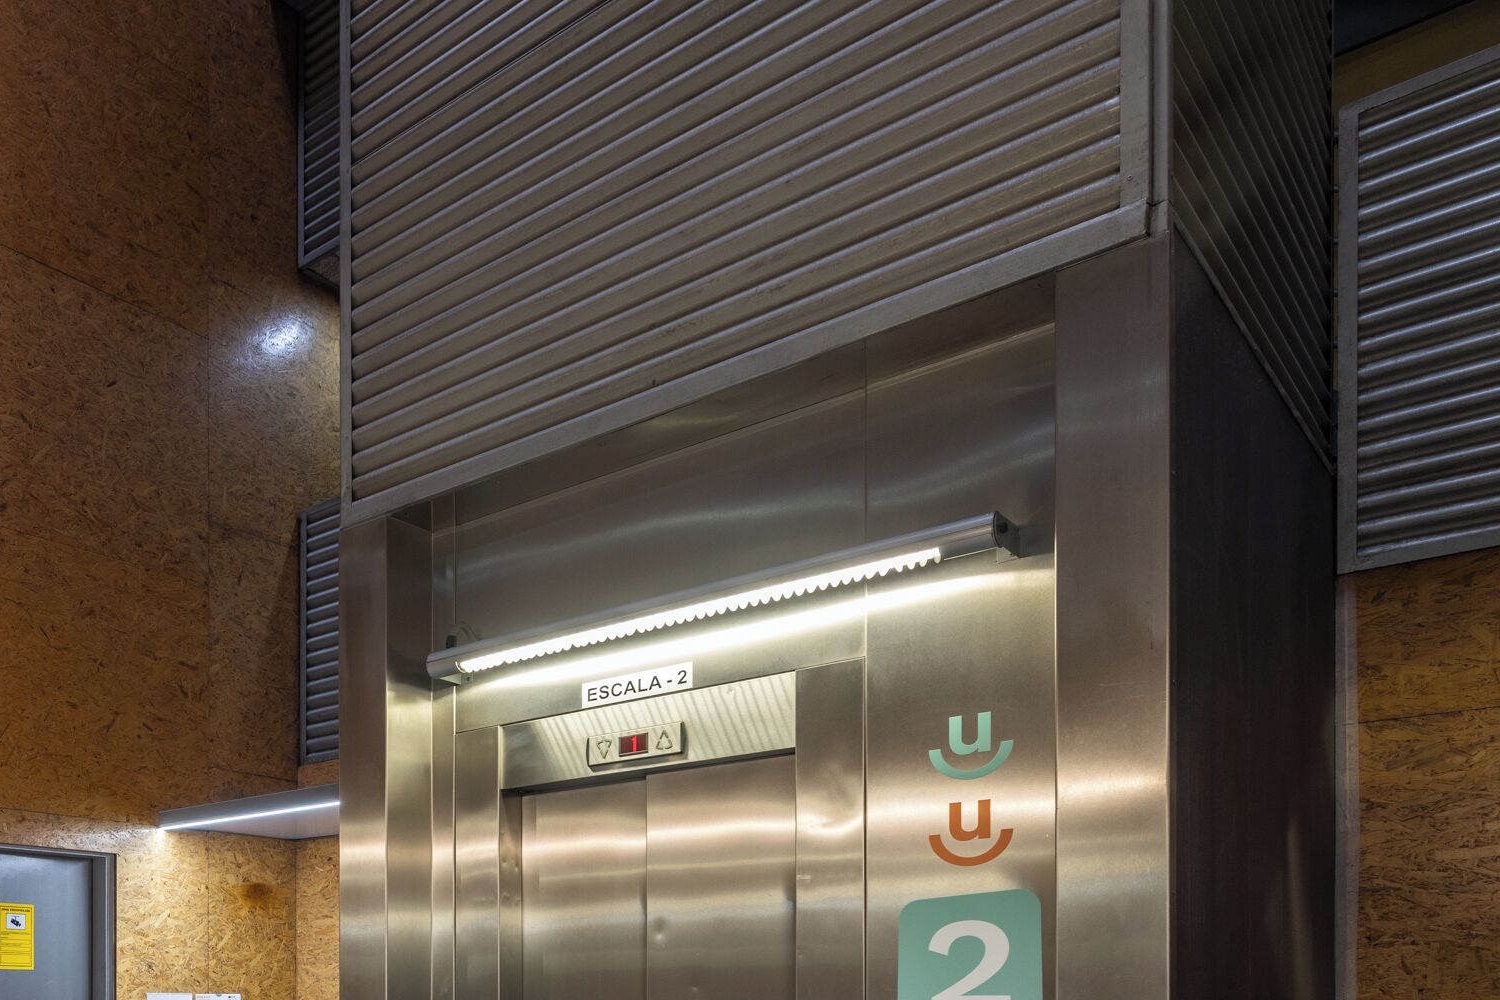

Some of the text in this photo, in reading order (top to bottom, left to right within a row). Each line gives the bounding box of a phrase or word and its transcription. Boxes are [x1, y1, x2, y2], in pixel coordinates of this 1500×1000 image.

[587, 675, 662, 702] ESCALA
[677, 669, 688, 685] 2
[630, 735, 637, 753] 1
